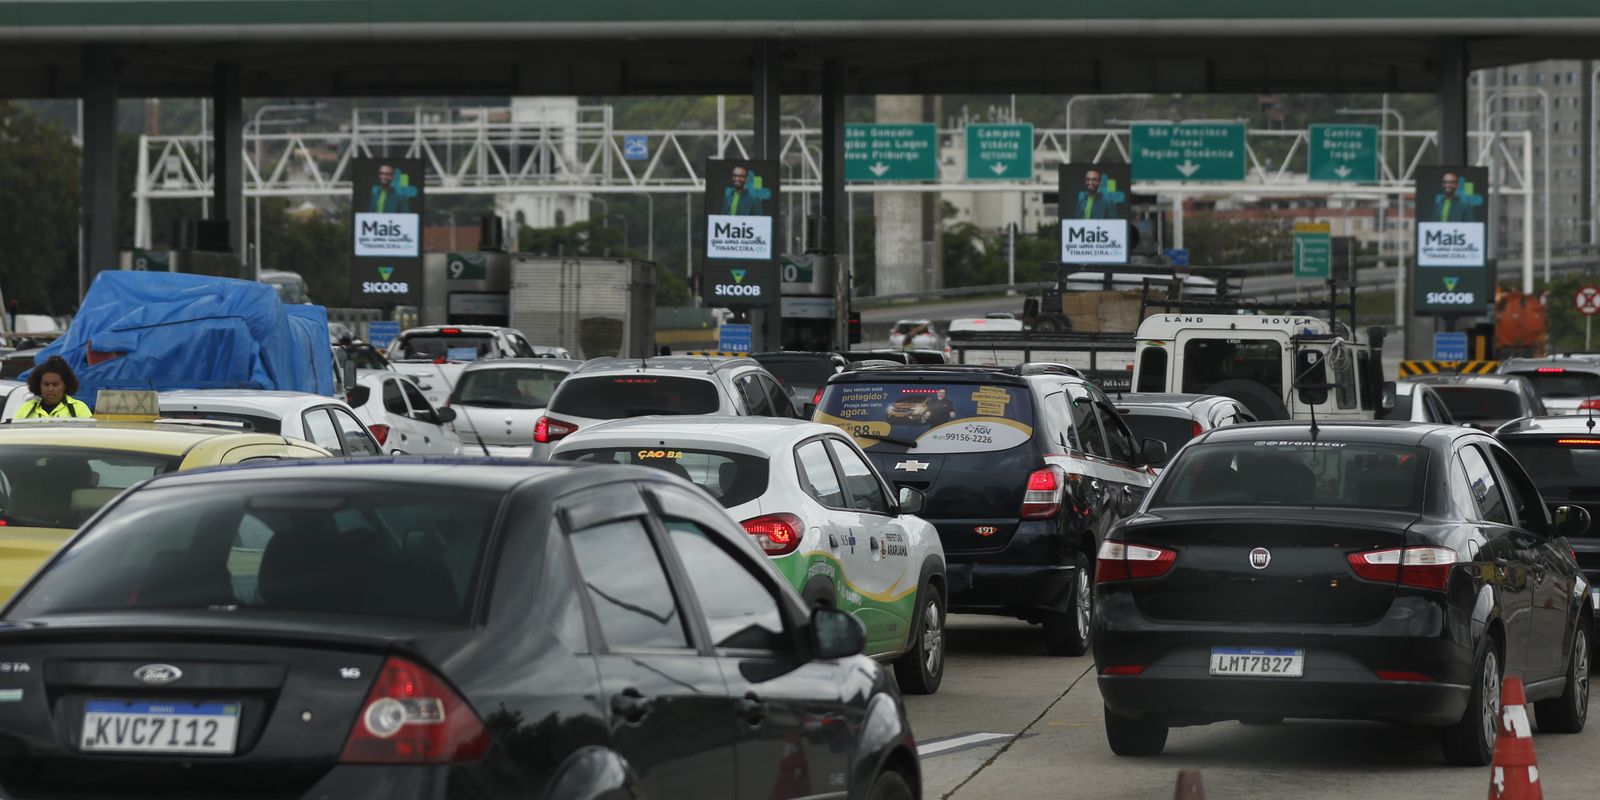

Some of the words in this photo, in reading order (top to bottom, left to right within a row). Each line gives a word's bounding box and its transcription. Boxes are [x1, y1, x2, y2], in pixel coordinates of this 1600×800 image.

[977, 129, 1021, 139] Campos
[1148, 127, 1168, 136] São
[1173, 127, 1228, 136] Francisco
[1324, 128, 1362, 138] Centro
[625, 139, 648, 154] 25
[845, 140, 867, 150] gião
[871, 140, 890, 148] dos
[895, 140, 928, 150] Lagos
[980, 139, 1019, 149] Vitória
[1170, 137, 1203, 147] Icaraí
[1323, 139, 1362, 149] Barcas
[845, 151, 868, 160] ova
[872, 151, 919, 161] Friburgo
[1141, 148, 1179, 160] Região
[1184, 148, 1234, 158] Oceânica
[362, 220, 401, 236] Mais
[714, 222, 754, 239] Mais
[1069, 226, 1109, 243] Mais
[1426, 229, 1466, 245] Mais
[450, 260, 464, 278] 9
[362, 282, 408, 293] SICOOB
[715, 284, 761, 296] SICOOB
[1426, 292, 1474, 304] SICOOB
[101, 392, 156, 413] TAXI
[842, 392, 888, 403] protegido?
[841, 408, 869, 418] agora.
[1254, 553, 1266, 564] FIAT
[0, 662, 31, 672] STA
[1218, 655, 1293, 673] LMT7B27
[95, 716, 219, 747] KVC7I12
